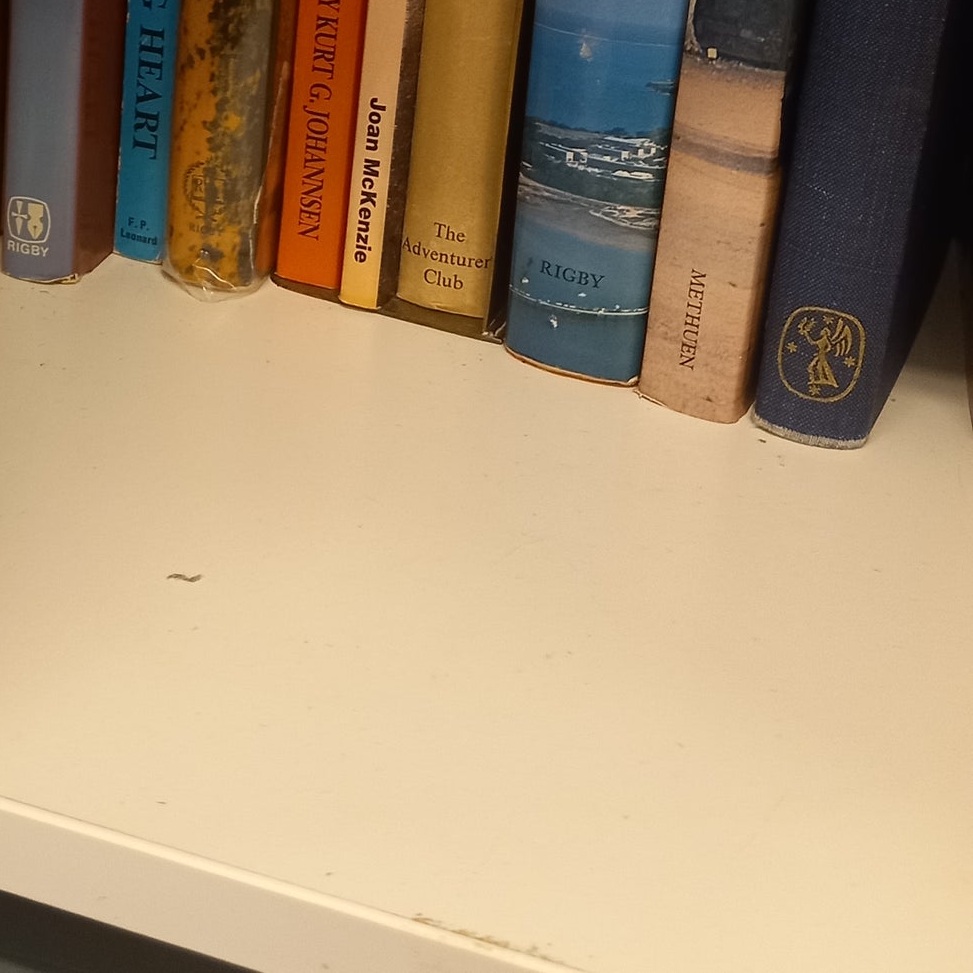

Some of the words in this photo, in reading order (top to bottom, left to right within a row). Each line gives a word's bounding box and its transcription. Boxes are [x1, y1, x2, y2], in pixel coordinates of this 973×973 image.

[312, 16, 339, 80] KURT
[131, 25, 165, 160] HEART
[309, 82, 332, 103] G.
[365, 97, 387, 152] Joan
[297, 104, 330, 240] JOHANNSEN
[354, 159, 380, 263] McKenzie
[120, 229, 157, 246] Leonard
[434, 222, 466, 243] The
[7, 240, 49, 257] RIGBY
[402, 238, 491, 269] Adventurer
[424, 269, 464, 290] Club
[539, 259, 605, 289] RIGBY
[678, 268, 707, 370] METHUEN
